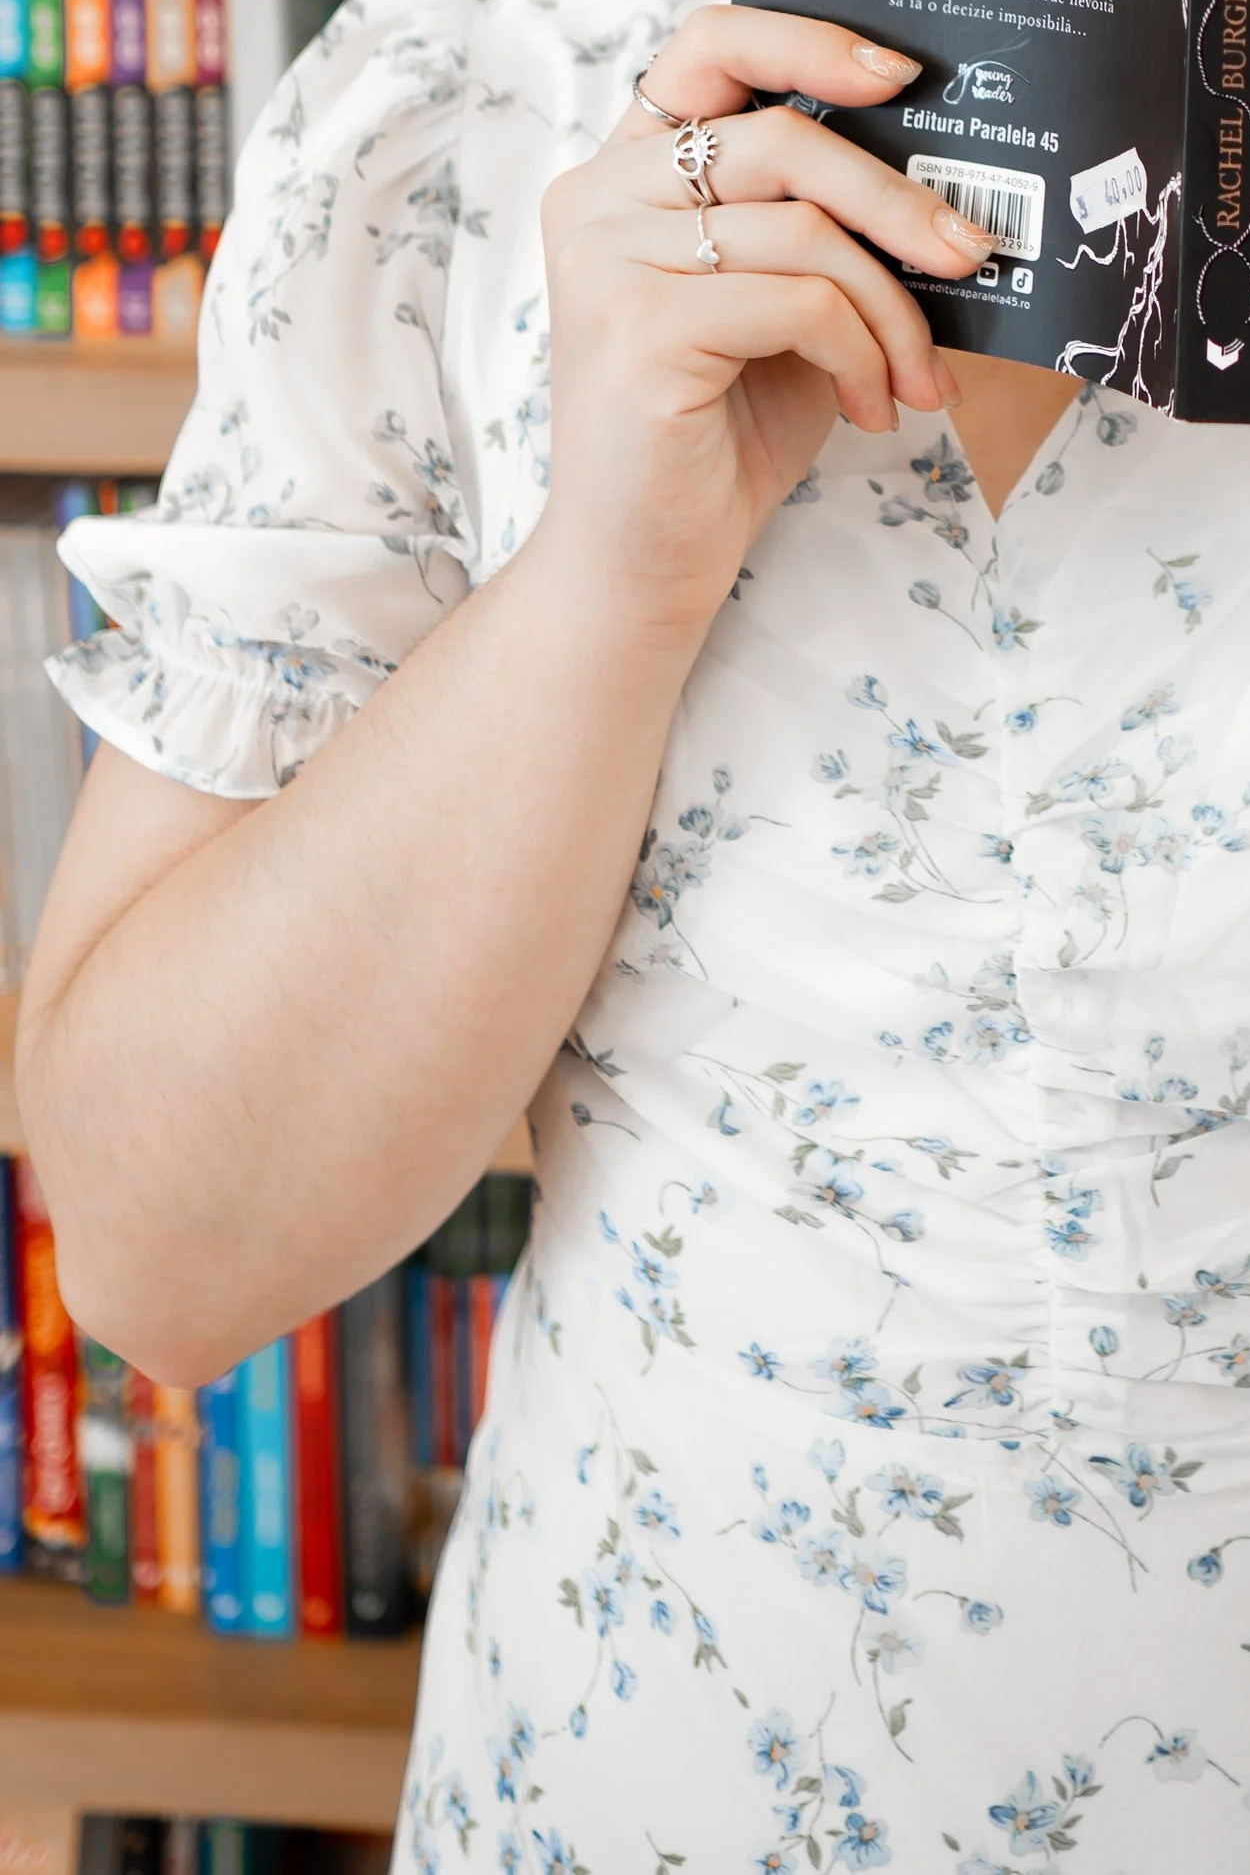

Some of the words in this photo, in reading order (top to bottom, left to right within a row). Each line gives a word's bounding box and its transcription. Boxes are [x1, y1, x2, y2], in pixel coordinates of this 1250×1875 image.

[928, 1, 937, 12] o
[903, 106, 964, 136] Editura
[970, 117, 1035, 149] Paralela
[1040, 130, 1059, 153] 45
[916, 160, 942, 174] ISBN
[1217, 107, 1245, 229] RACHEL
